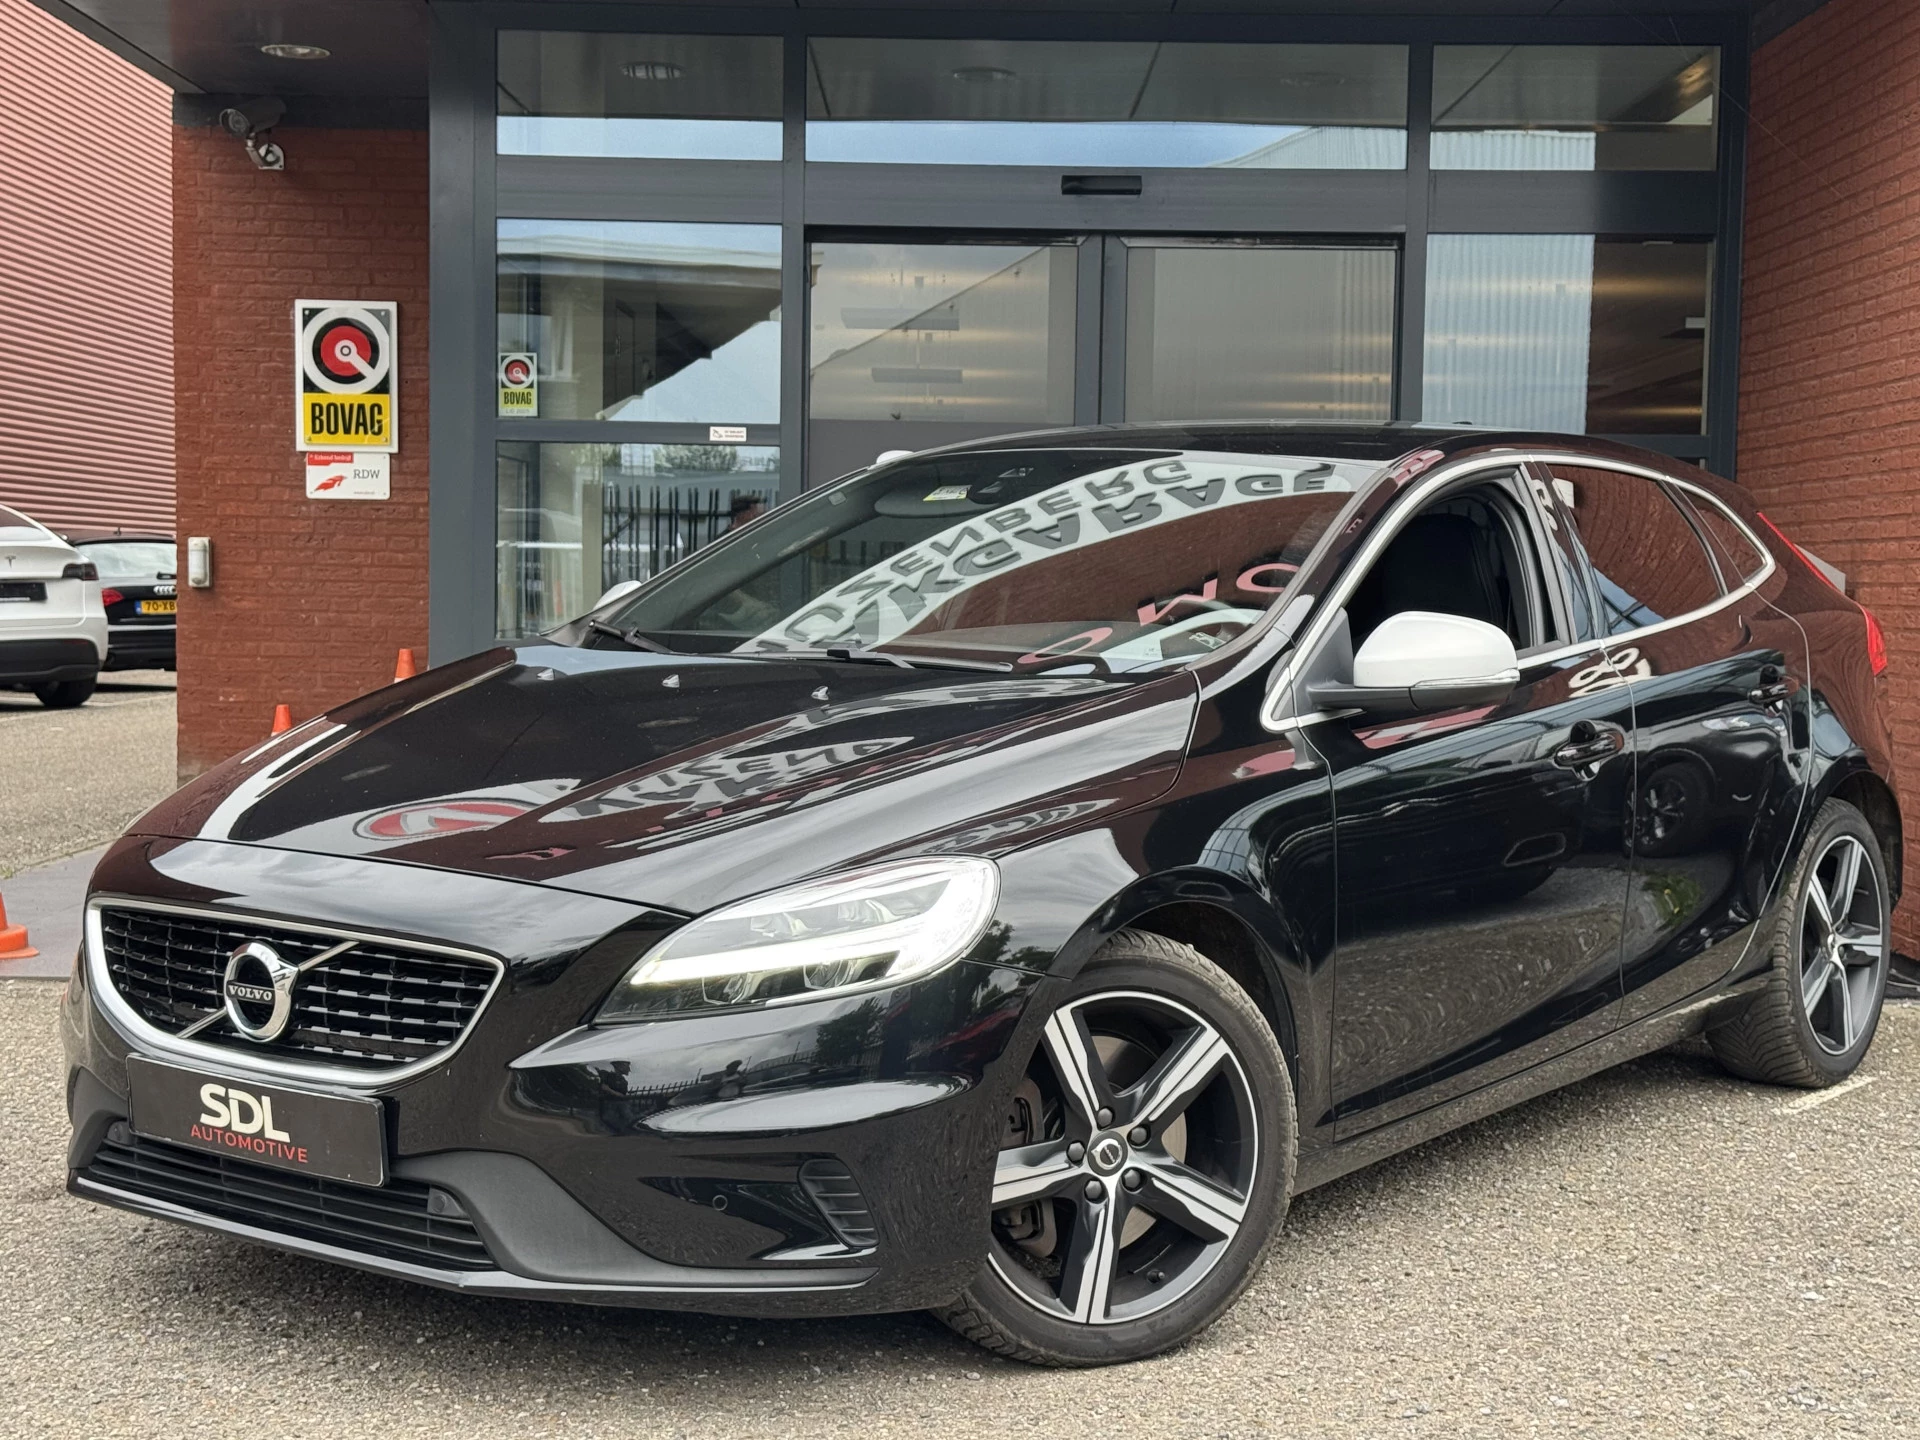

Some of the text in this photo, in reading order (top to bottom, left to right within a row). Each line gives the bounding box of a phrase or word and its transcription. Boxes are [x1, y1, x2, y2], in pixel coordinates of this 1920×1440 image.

[504, 391, 532, 405] BOVAG
[311, 403, 383, 436] BOVAG
[353, 469, 380, 479] RDW
[228, 985, 273, 1001] VOLVO
[200, 1083, 291, 1143] SDL
[191, 1124, 308, 1163] AUTOMOTIVE
